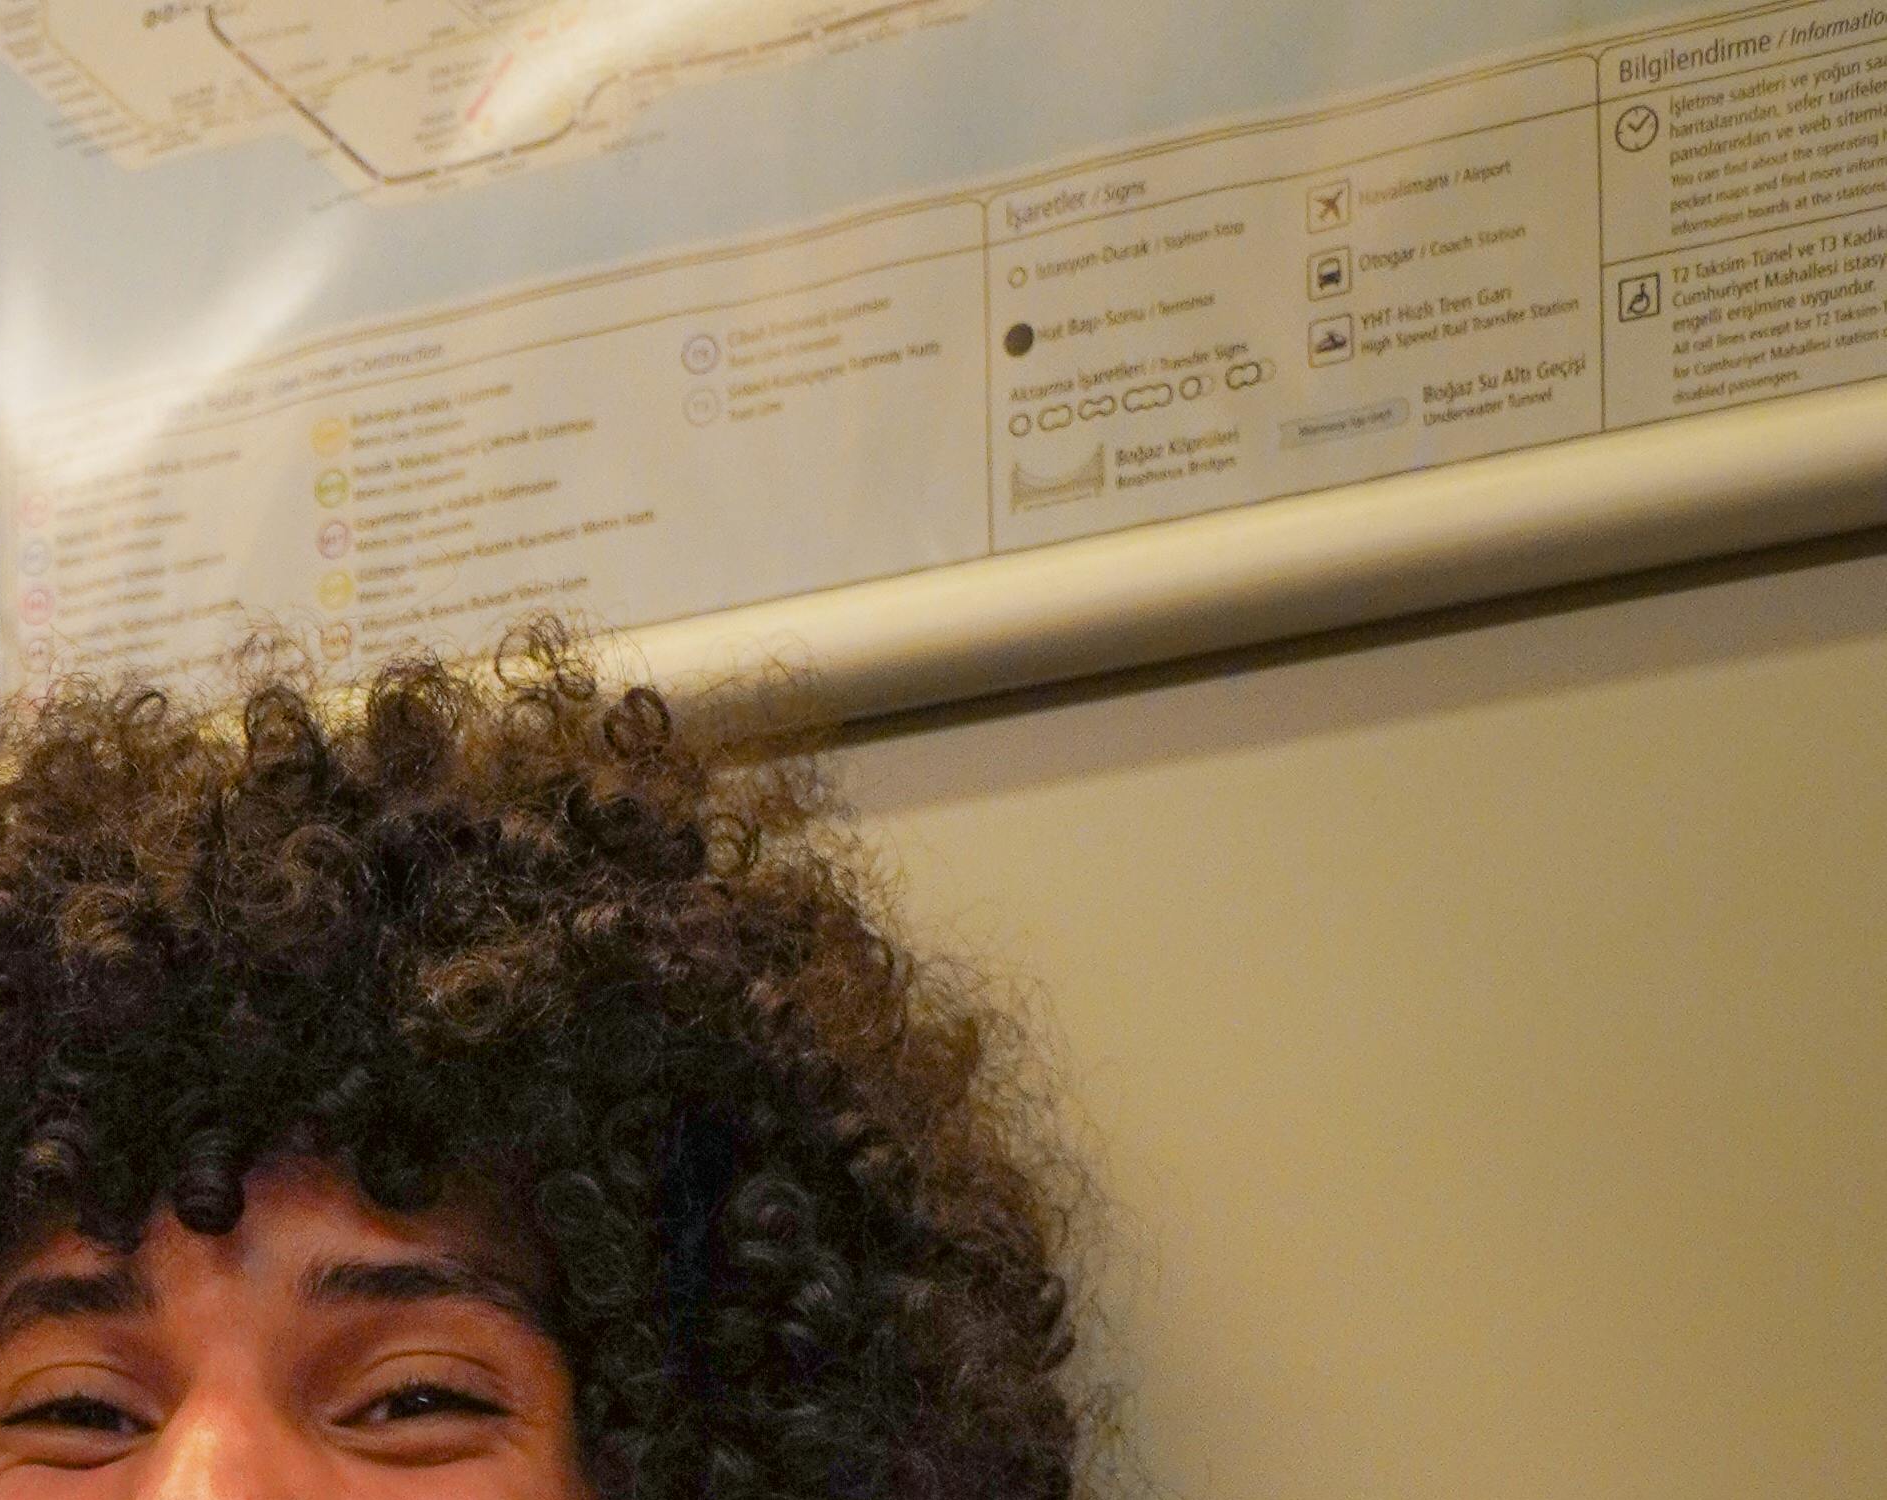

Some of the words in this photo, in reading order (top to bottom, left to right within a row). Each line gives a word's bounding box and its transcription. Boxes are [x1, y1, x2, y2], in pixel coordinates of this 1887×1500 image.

[1619, 33, 1771, 83] Bilgilendirme
[1790, 8, 1887, 46] Informatio
[1670, 94, 1725, 116] İşletme
[1730, 77, 1785, 100] saatleri
[1791, 74, 1807, 87] ve
[1814, 62, 1860, 87] yoğun
[1787, 95, 1822, 114] sefer
[1776, 126, 1793, 140] ve
[1799, 118, 1831, 136] web
[1698, 167, 1719, 180] can
[1724, 160, 1747, 175] find
[1752, 153, 1787, 169] about
[1793, 148, 1813, 161] the
[1817, 134, 1877, 157] operating
[1463, 159, 1512, 184] Airport
[1753, 178, 1777, 193] and
[1781, 172, 1805, 187] find
[1810, 165, 1842, 181] more
[1748, 200, 1789, 219] boards
[1794, 196, 1807, 211] at
[1811, 192, 1832, 205] the
[1359, 246, 1415, 273] Otogar
[1478, 224, 1526, 246] Station
[1673, 268, 1689, 284] T2
[1797, 244, 1814, 257] ve
[1820, 236, 1837, 253] T3
[1673, 276, 1759, 308] Cumhuriyet
[1765, 262, 1838, 287] Mahallesi
[1531, 296, 1579, 319] Station
[1673, 308, 1721, 333] engelli
[1717, 329, 1745, 346] lines
[1750, 321, 1791, 342] except
[1695, 351, 1767, 376] Cumhuriyet
[1770, 336, 1831, 361] Mahallesi
[1835, 326, 1879, 348] station
[1478, 373, 1498, 391] Su
